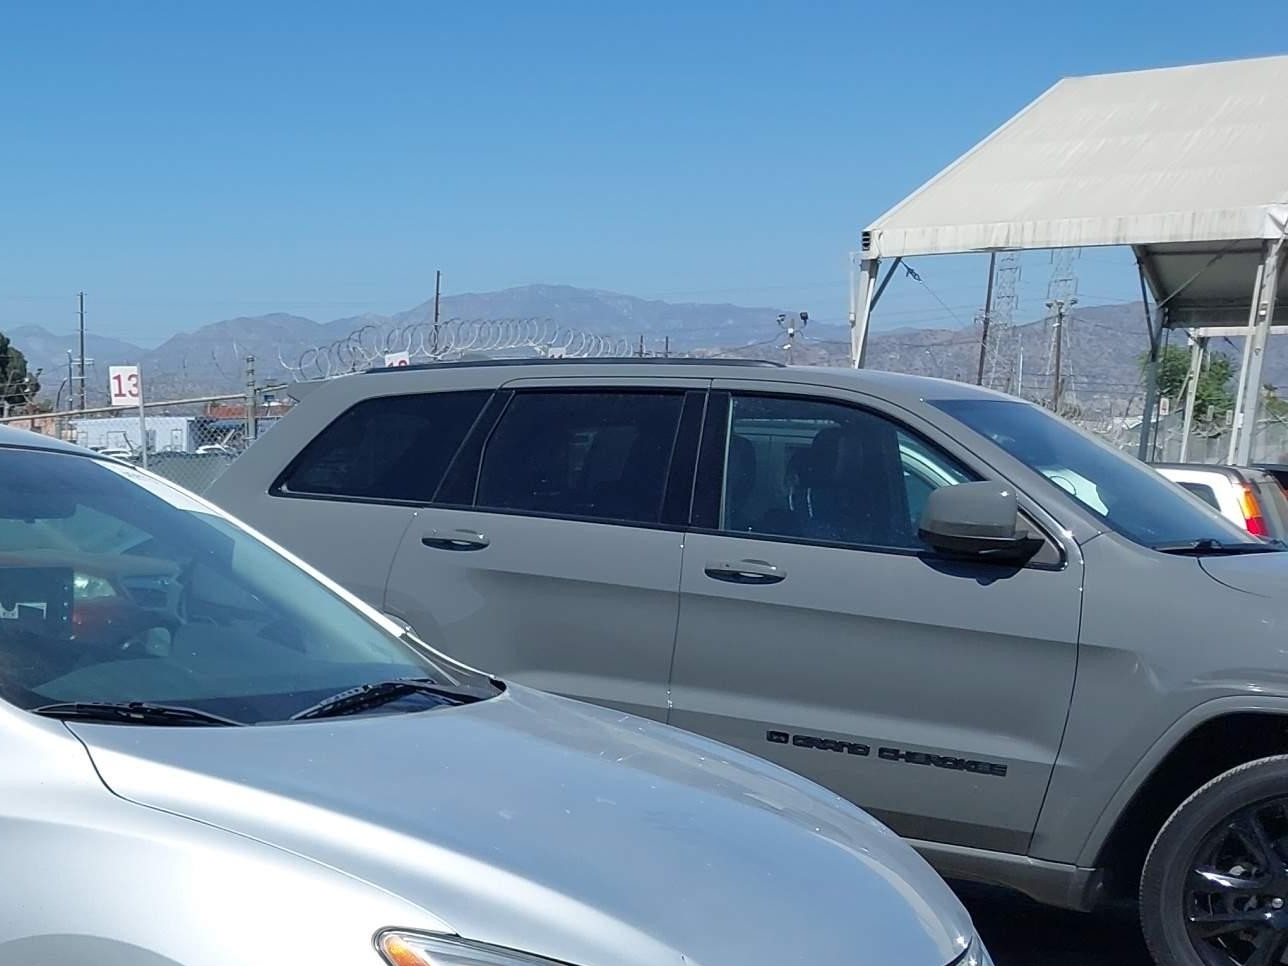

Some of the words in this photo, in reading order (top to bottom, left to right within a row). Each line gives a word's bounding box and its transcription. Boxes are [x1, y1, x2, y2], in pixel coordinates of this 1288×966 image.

[112, 374, 139, 397] 13
[793, 734, 870, 756] GRAND
[878, 747, 1008, 777] CHEROKEE
